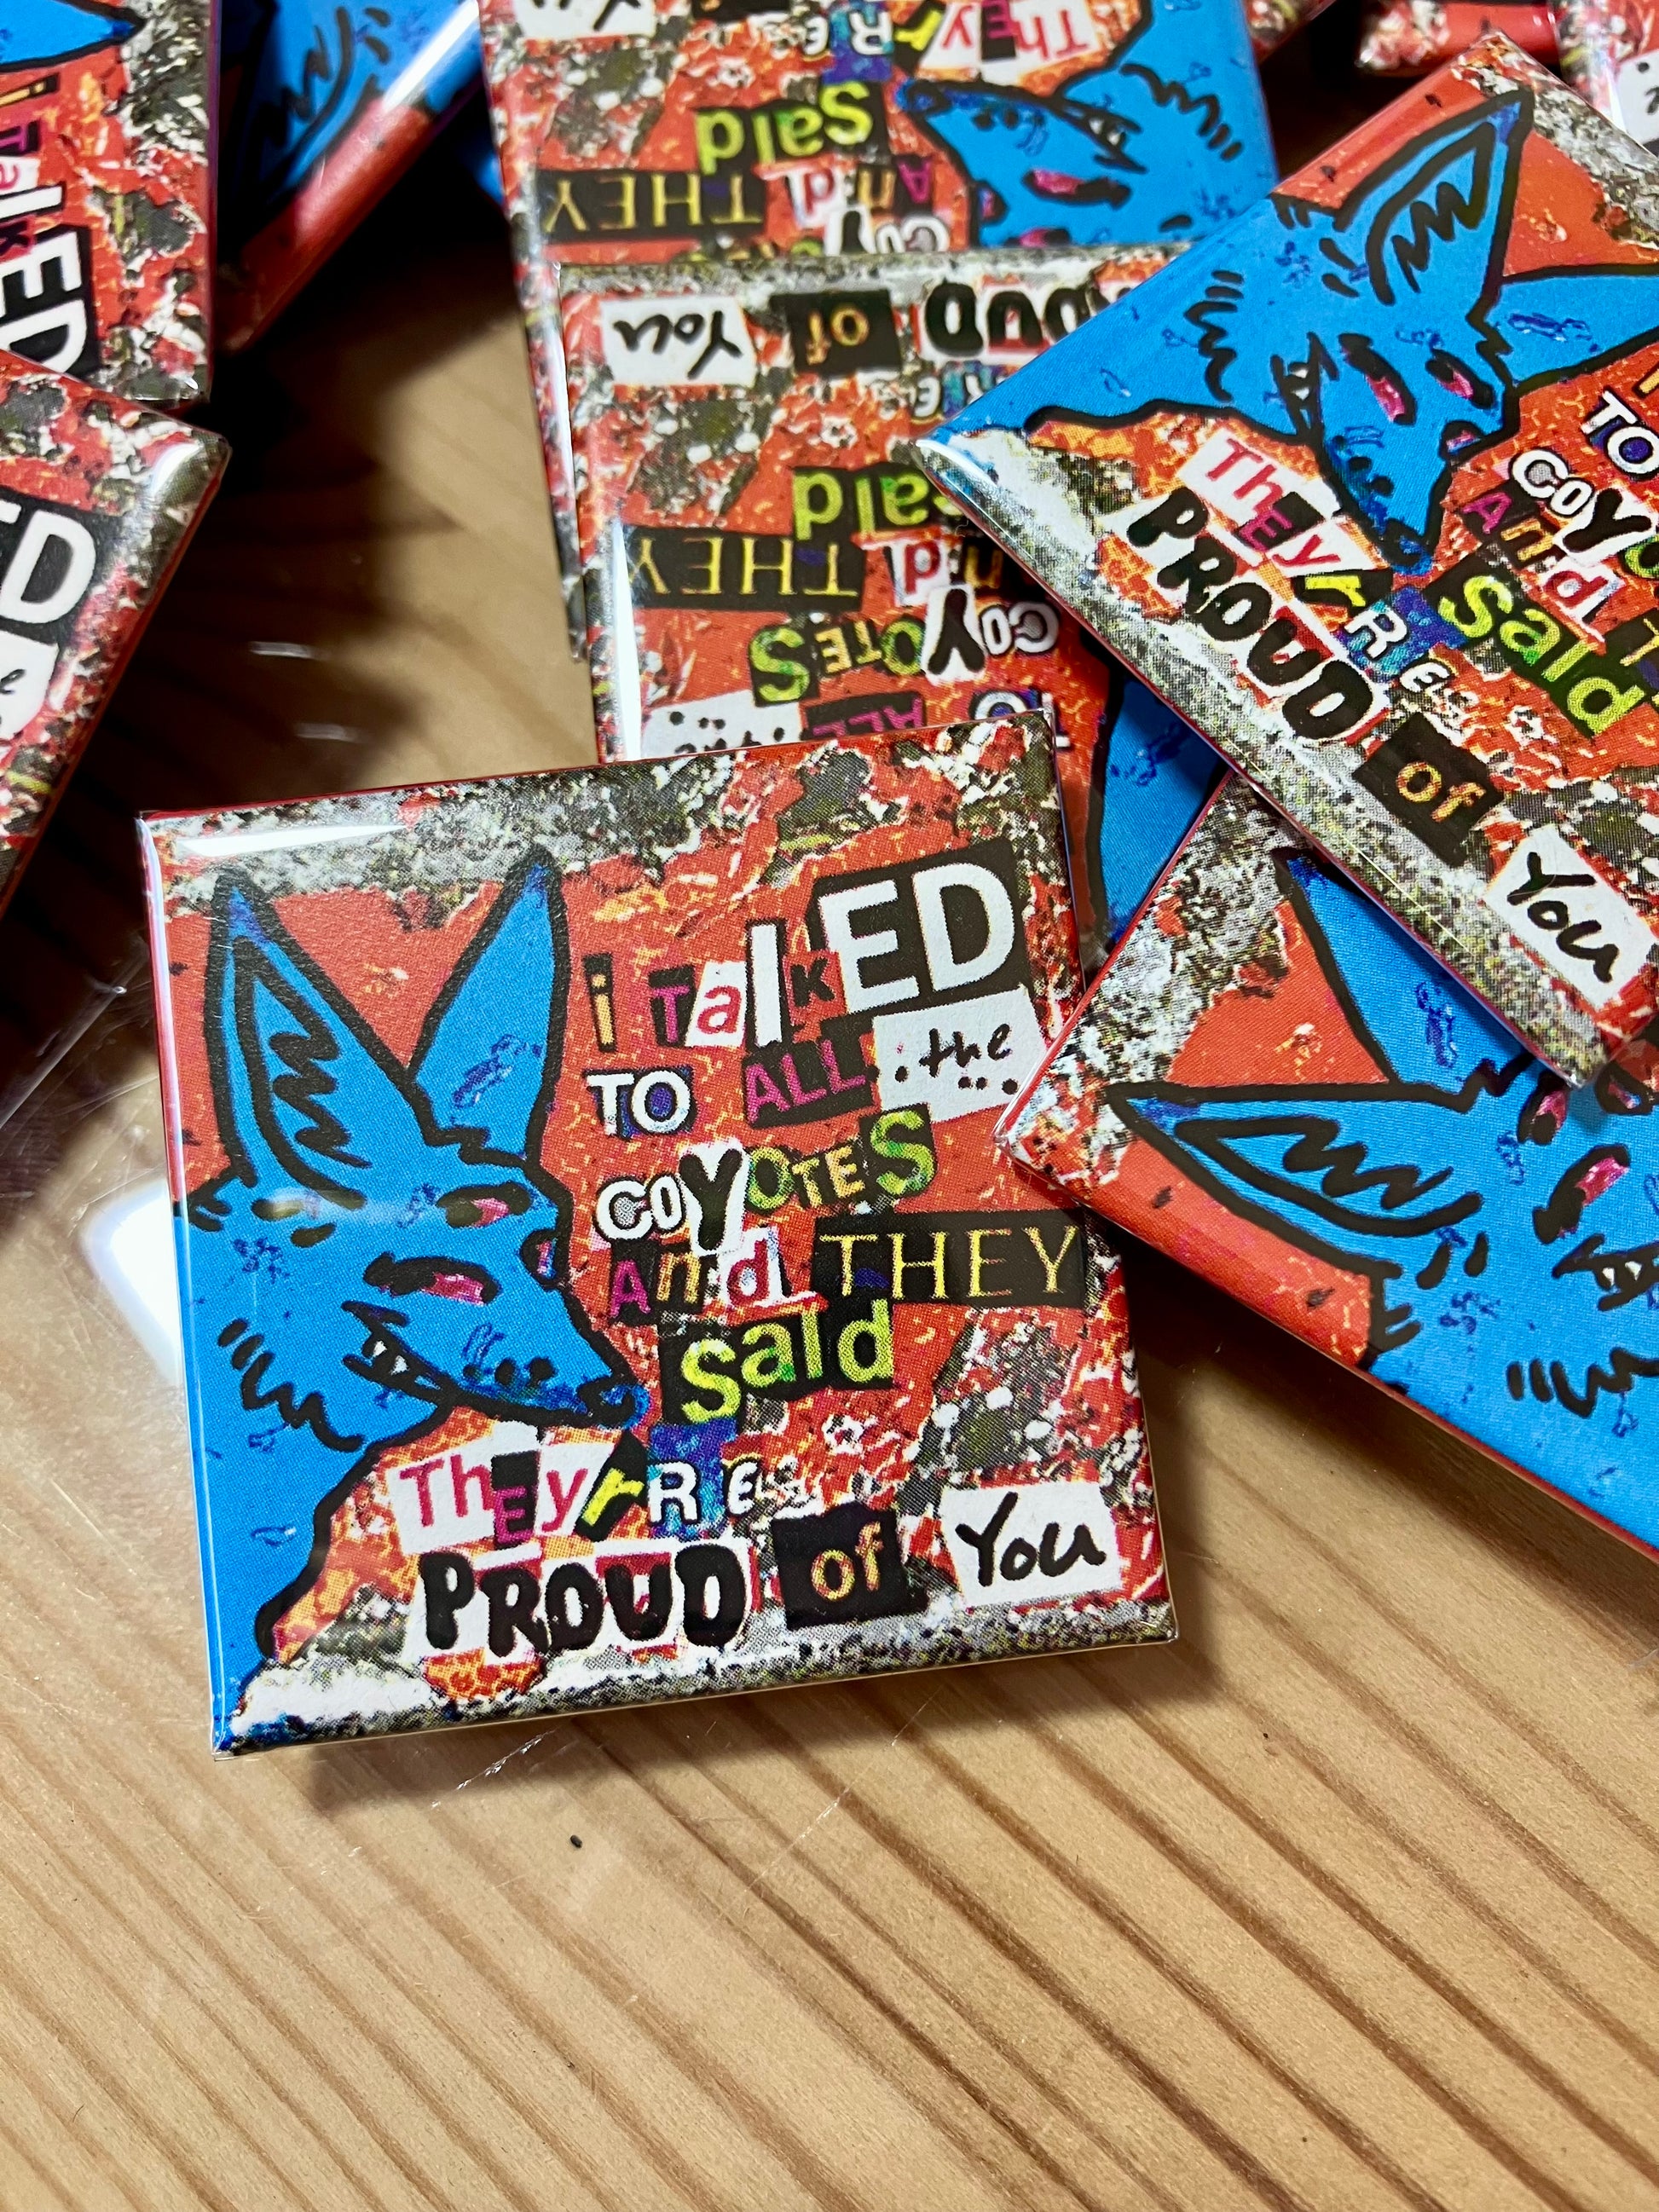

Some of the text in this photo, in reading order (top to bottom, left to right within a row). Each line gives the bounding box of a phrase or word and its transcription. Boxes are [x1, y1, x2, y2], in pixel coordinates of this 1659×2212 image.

[544, 173, 762, 232] THEY
[613, 309, 742, 378] You
[808, 308, 869, 366] of
[1581, 390, 1659, 474] TO
[628, 537, 858, 595] THEY
[750, 589, 1060, 702] COYOTES
[1127, 489, 1374, 740] PROUD
[1397, 760, 1486, 823] of
[1509, 851, 1620, 983] You
[587, 1071, 692, 1135] TO
[744, 1039, 867, 1121] ALL
[596, 1110, 935, 1251] COYOTES
[821, 1224, 1079, 1300] THEY
[419, 1493, 1107, 1658] PROUD of You
